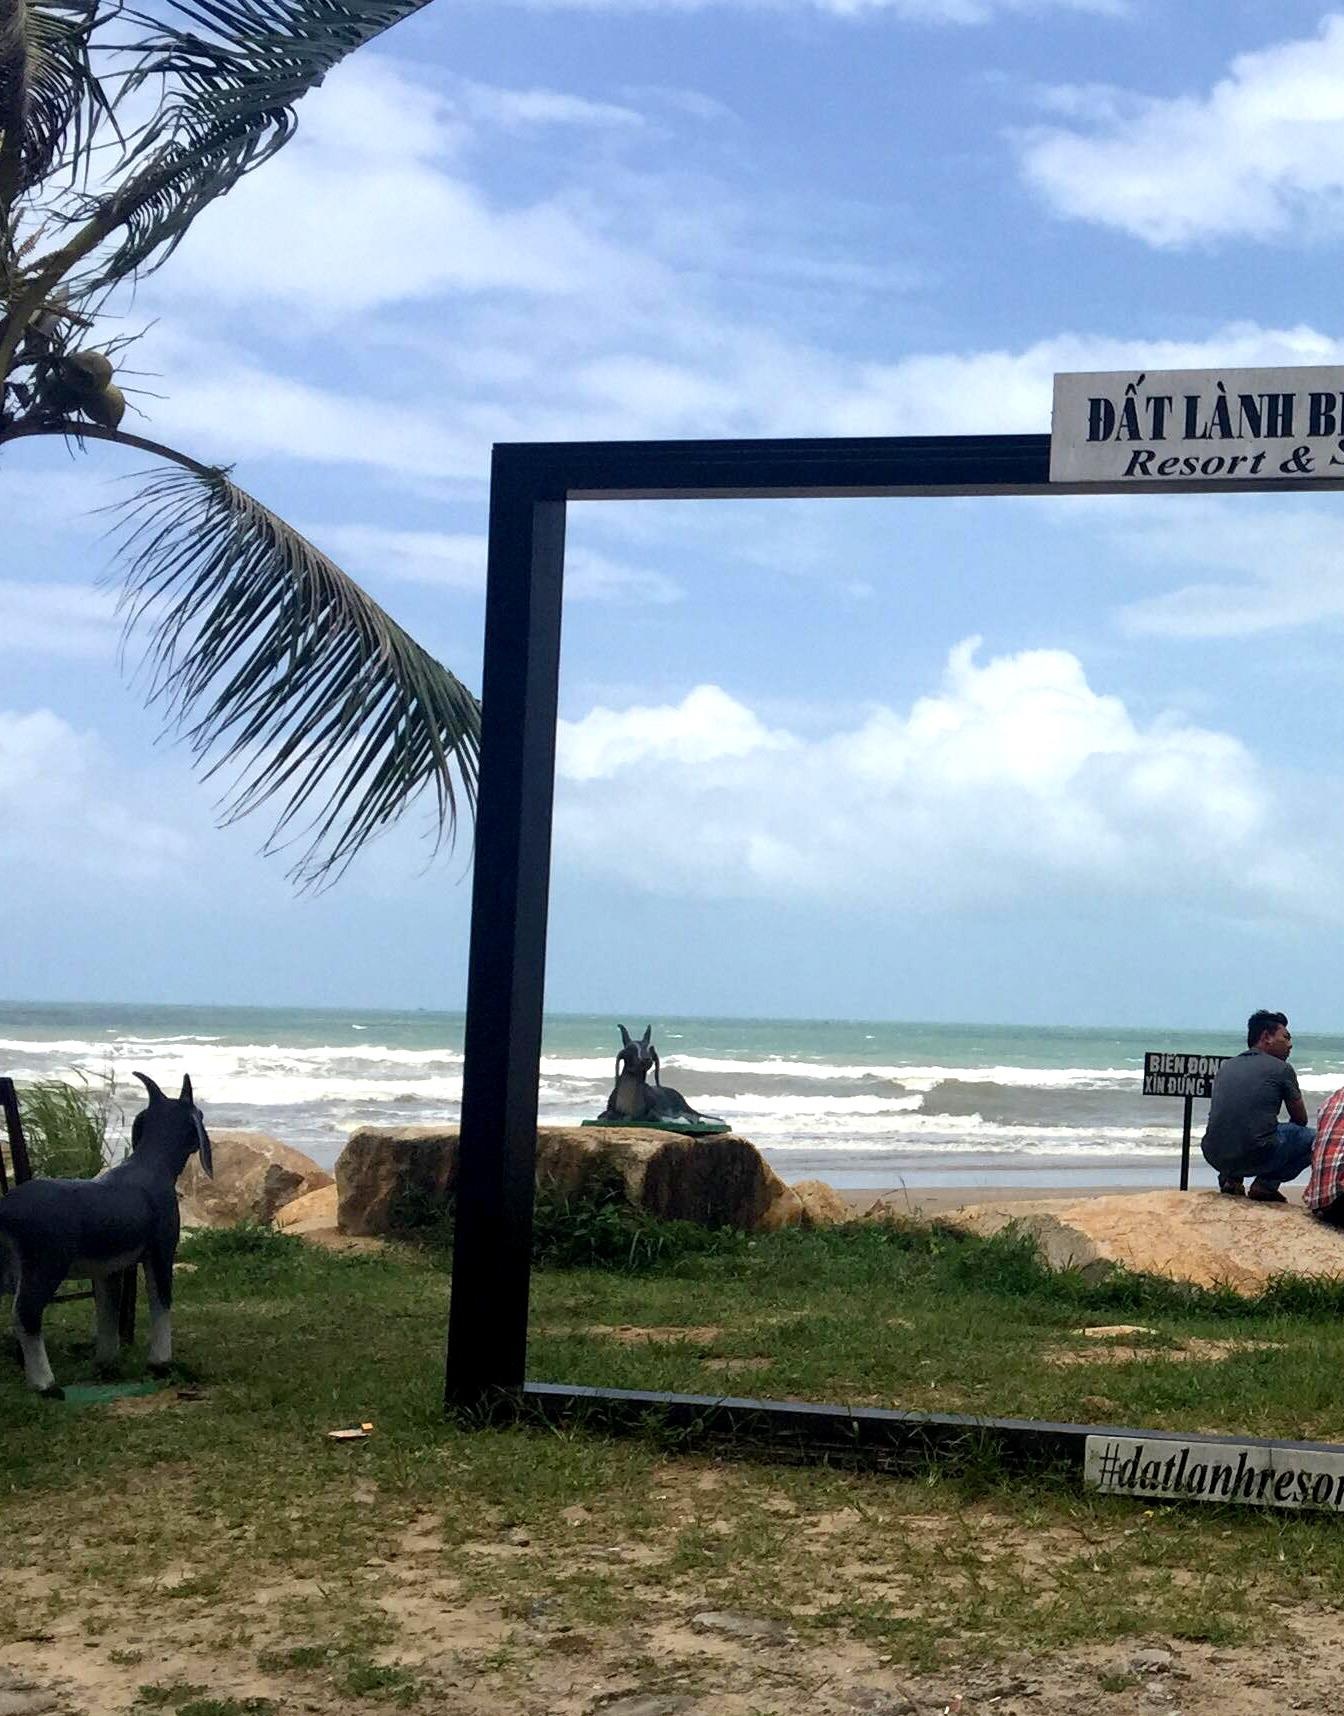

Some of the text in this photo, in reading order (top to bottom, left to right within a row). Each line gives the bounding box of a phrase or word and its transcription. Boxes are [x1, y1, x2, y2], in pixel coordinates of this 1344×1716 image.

[1086, 373, 1173, 442] ĐẤT
[1182, 380, 1297, 441] LÀNH
[1122, 448, 1267, 477] Resort
[1279, 445, 1316, 473] &
